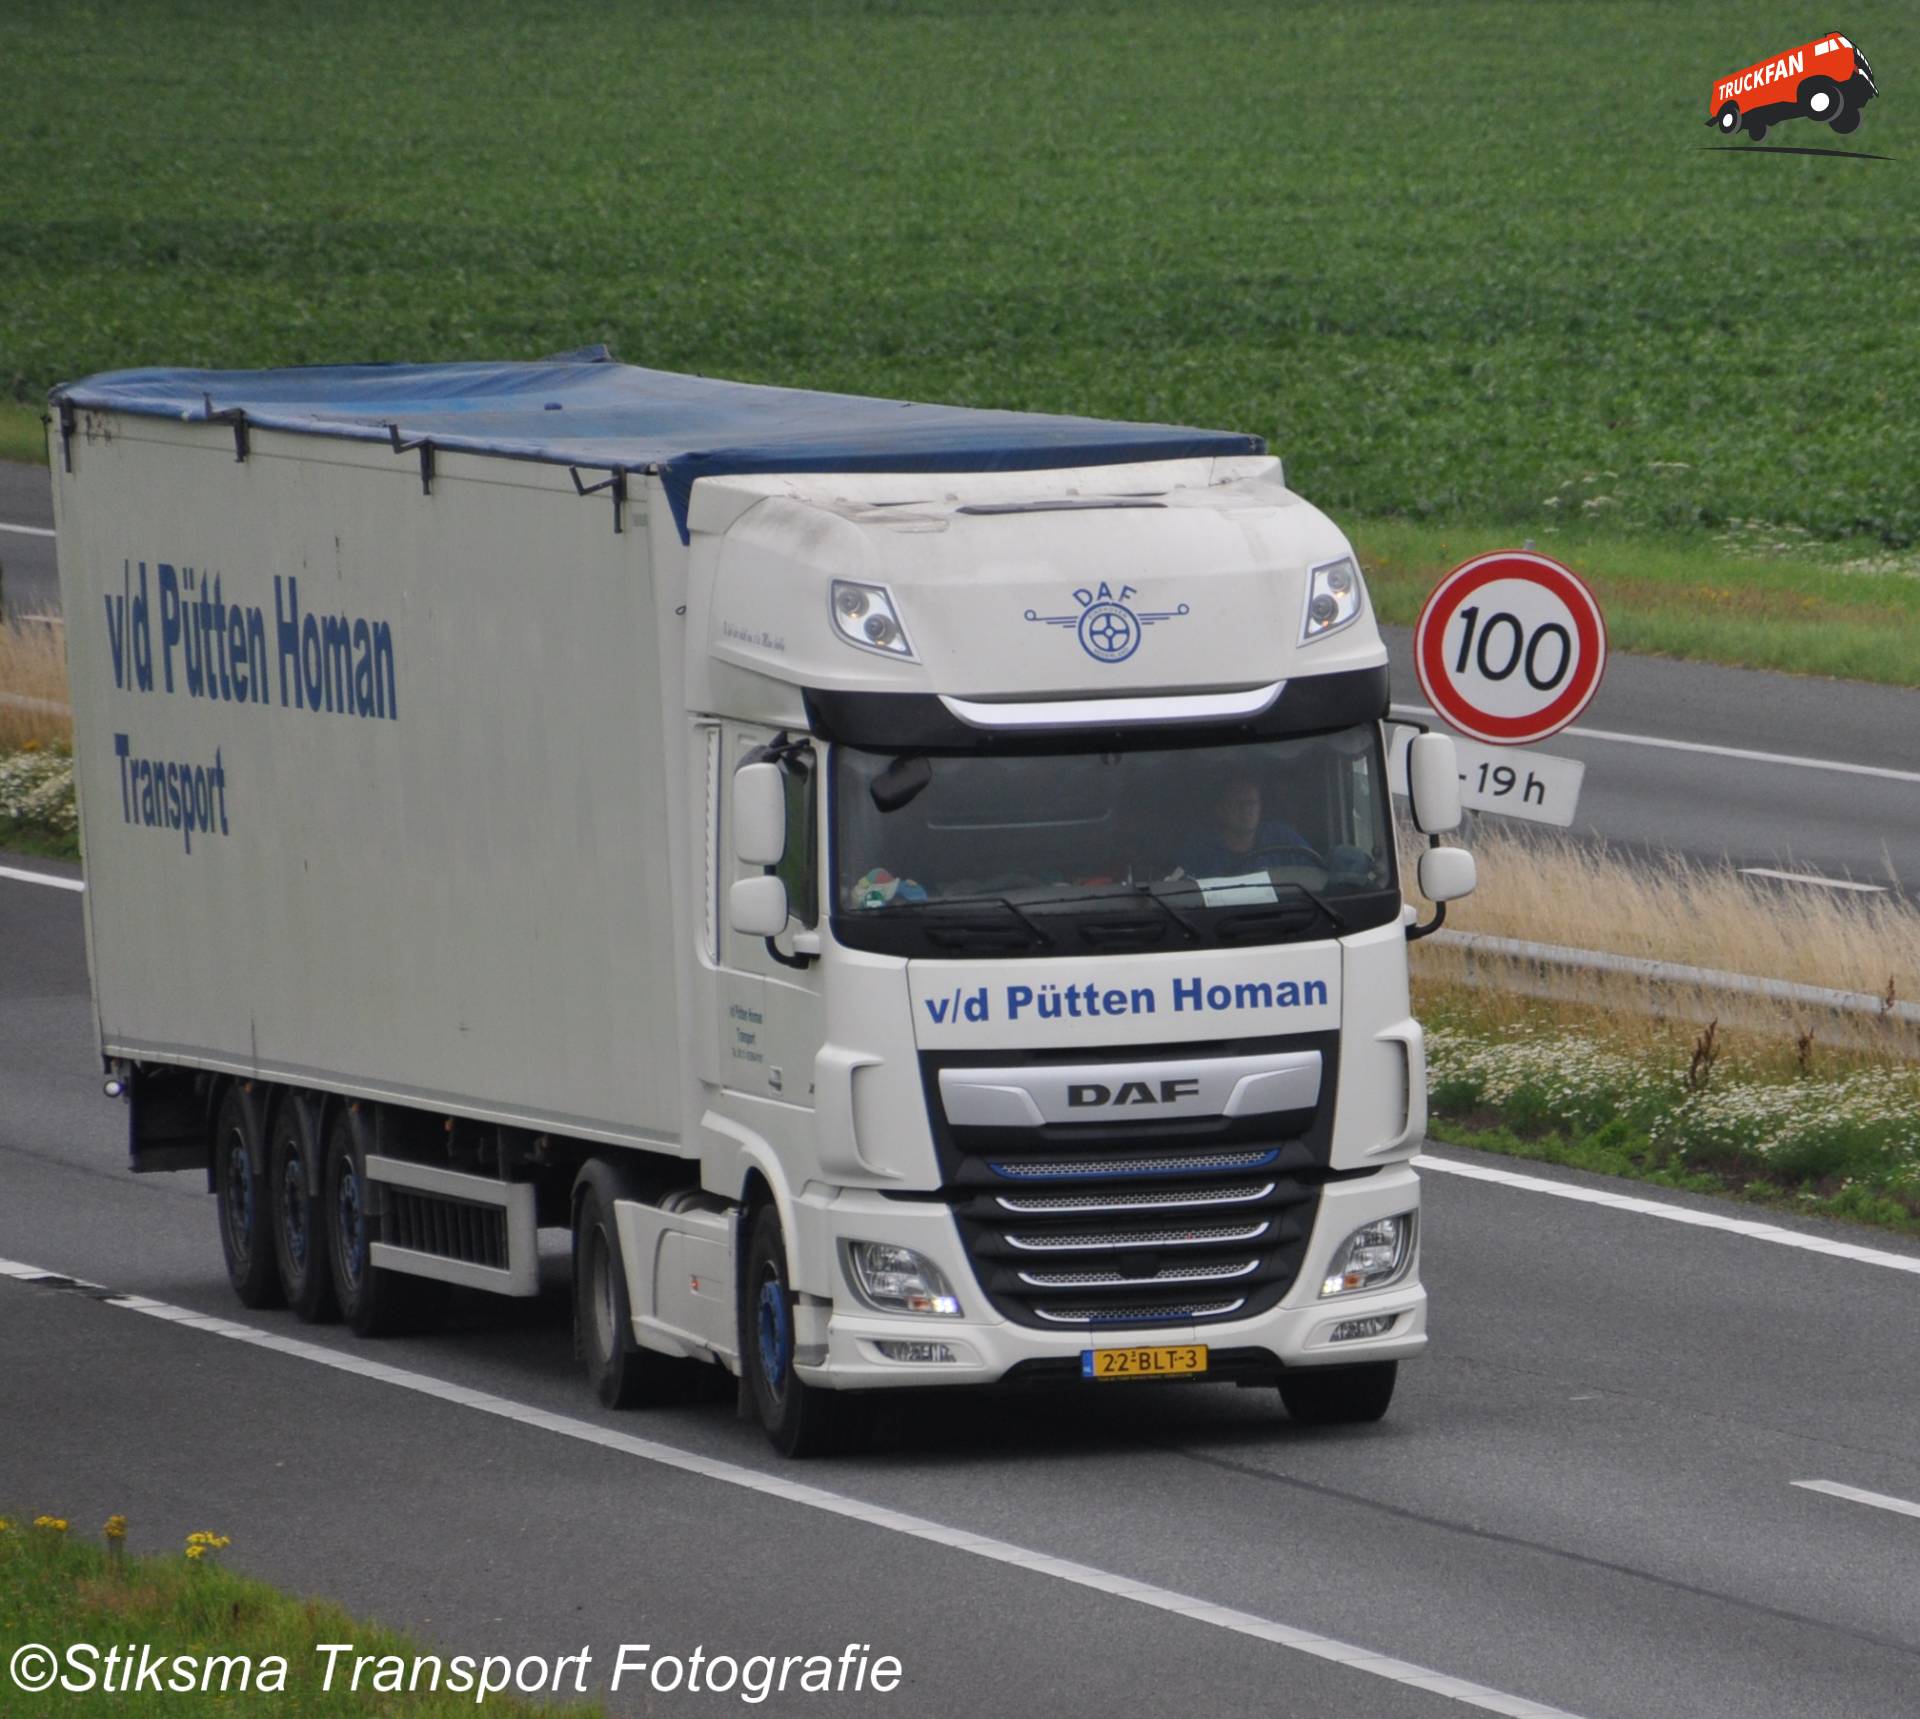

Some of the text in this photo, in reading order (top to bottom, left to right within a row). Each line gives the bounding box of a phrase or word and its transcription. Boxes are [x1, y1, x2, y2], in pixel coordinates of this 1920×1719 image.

[1072, 581, 1138, 607] DAF
[104, 558, 398, 721] v/d Pütten Homan
[1455, 605, 1572, 692] 100
[114, 733, 229, 855] Transport
[1522, 771, 1546, 806] h
[925, 977, 1329, 1025] v/d Pütten Homan
[1067, 1079, 1200, 1108] DAF
